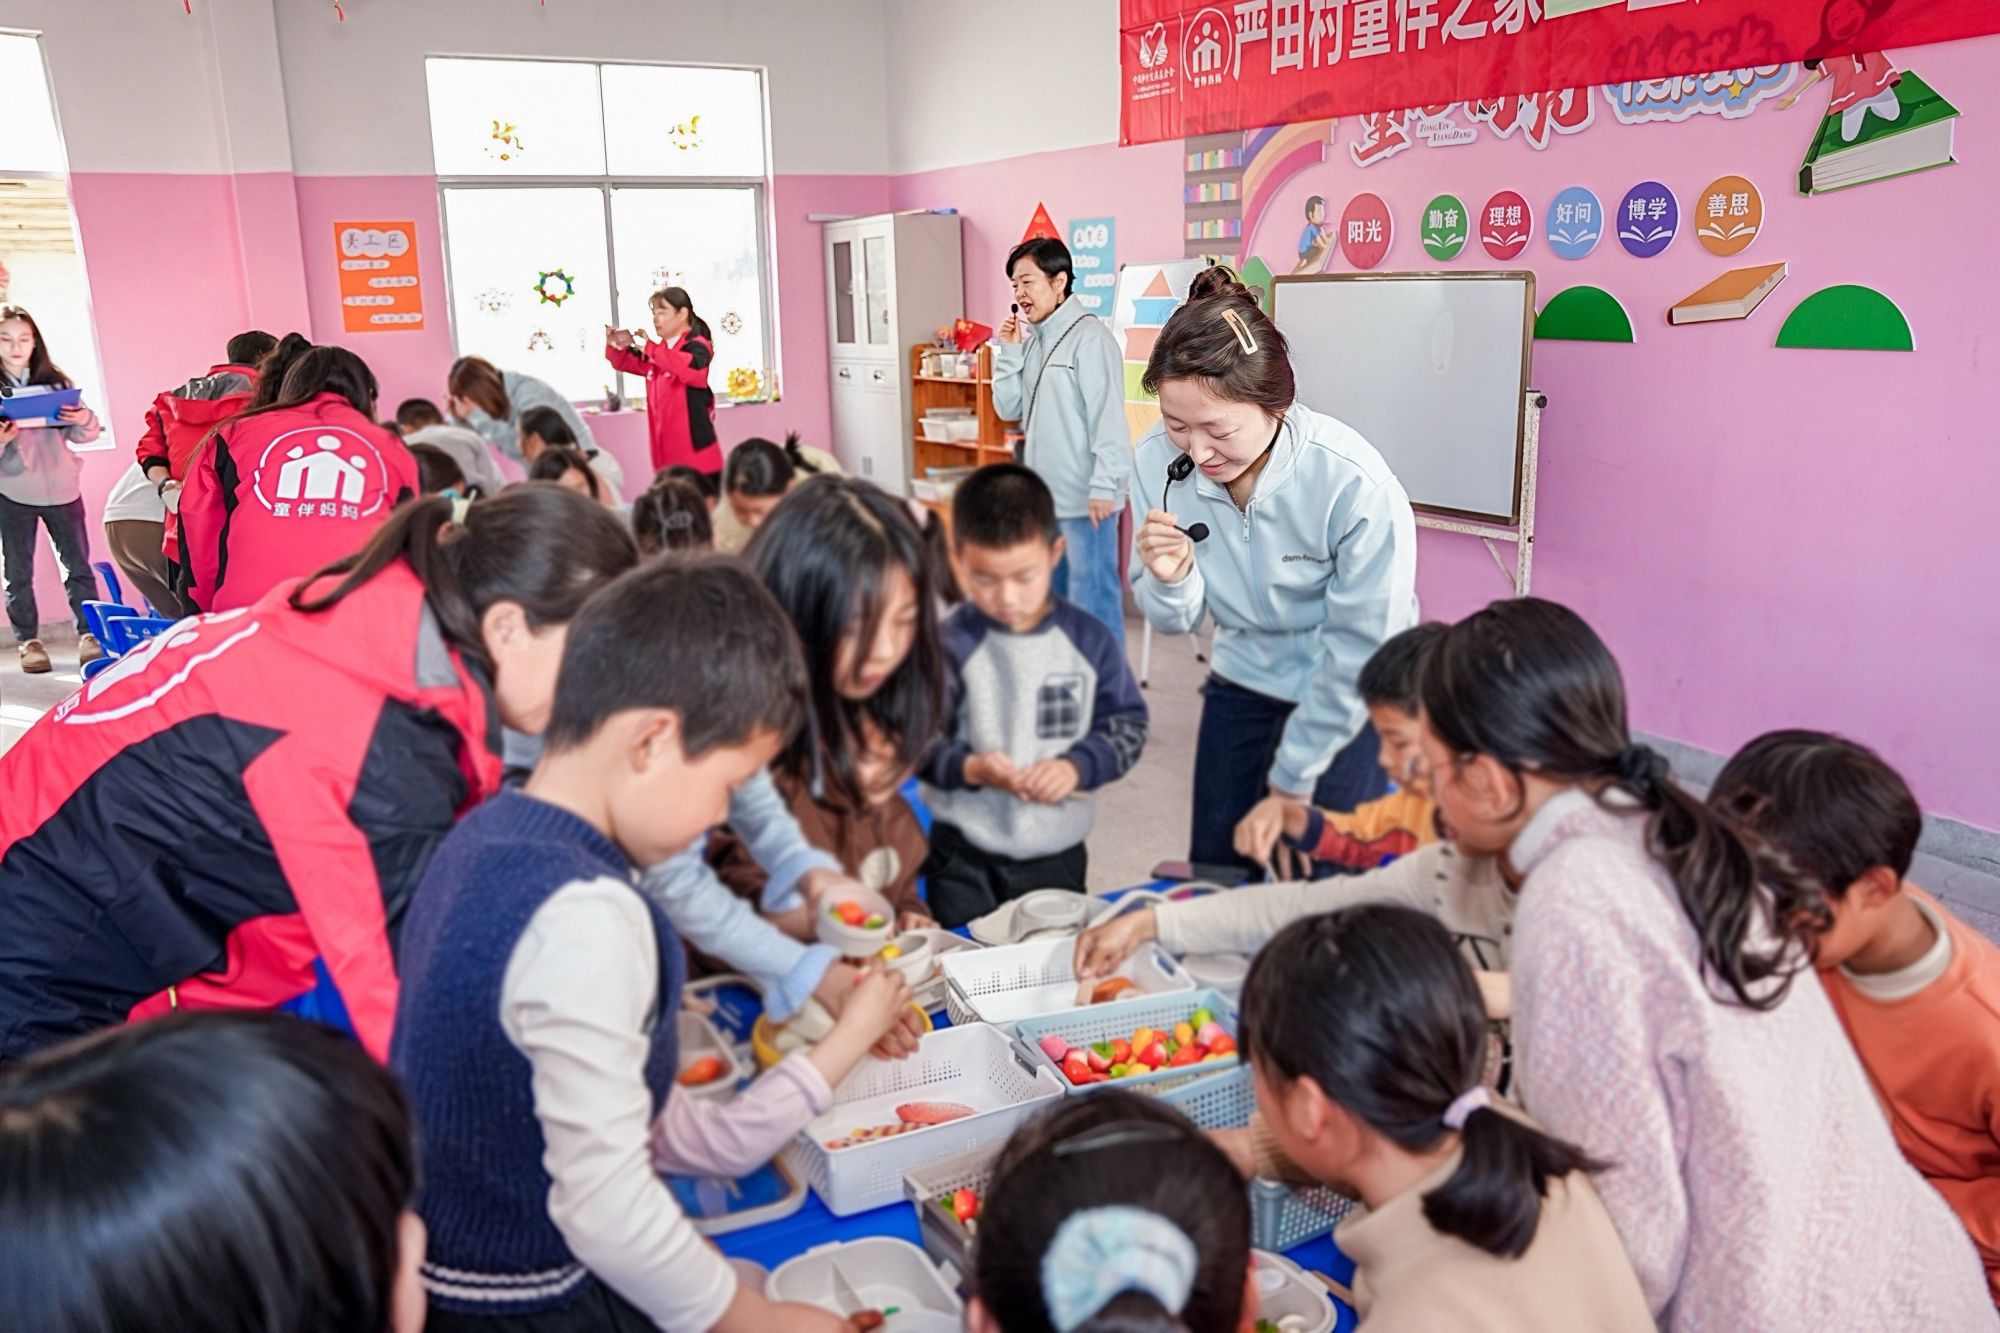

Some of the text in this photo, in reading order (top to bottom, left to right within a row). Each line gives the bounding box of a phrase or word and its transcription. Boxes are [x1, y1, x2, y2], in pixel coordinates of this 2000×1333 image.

[1555, 203, 1592, 224] 好问
[1627, 197, 1667, 221] 博学
[1707, 192, 1750, 218] 善思
[1428, 208, 1459, 230] 勤奋
[1489, 206, 1522, 227] 理想
[1347, 220, 1382, 244] 阳光
[272, 502, 359, 520] 童伴妈妈
